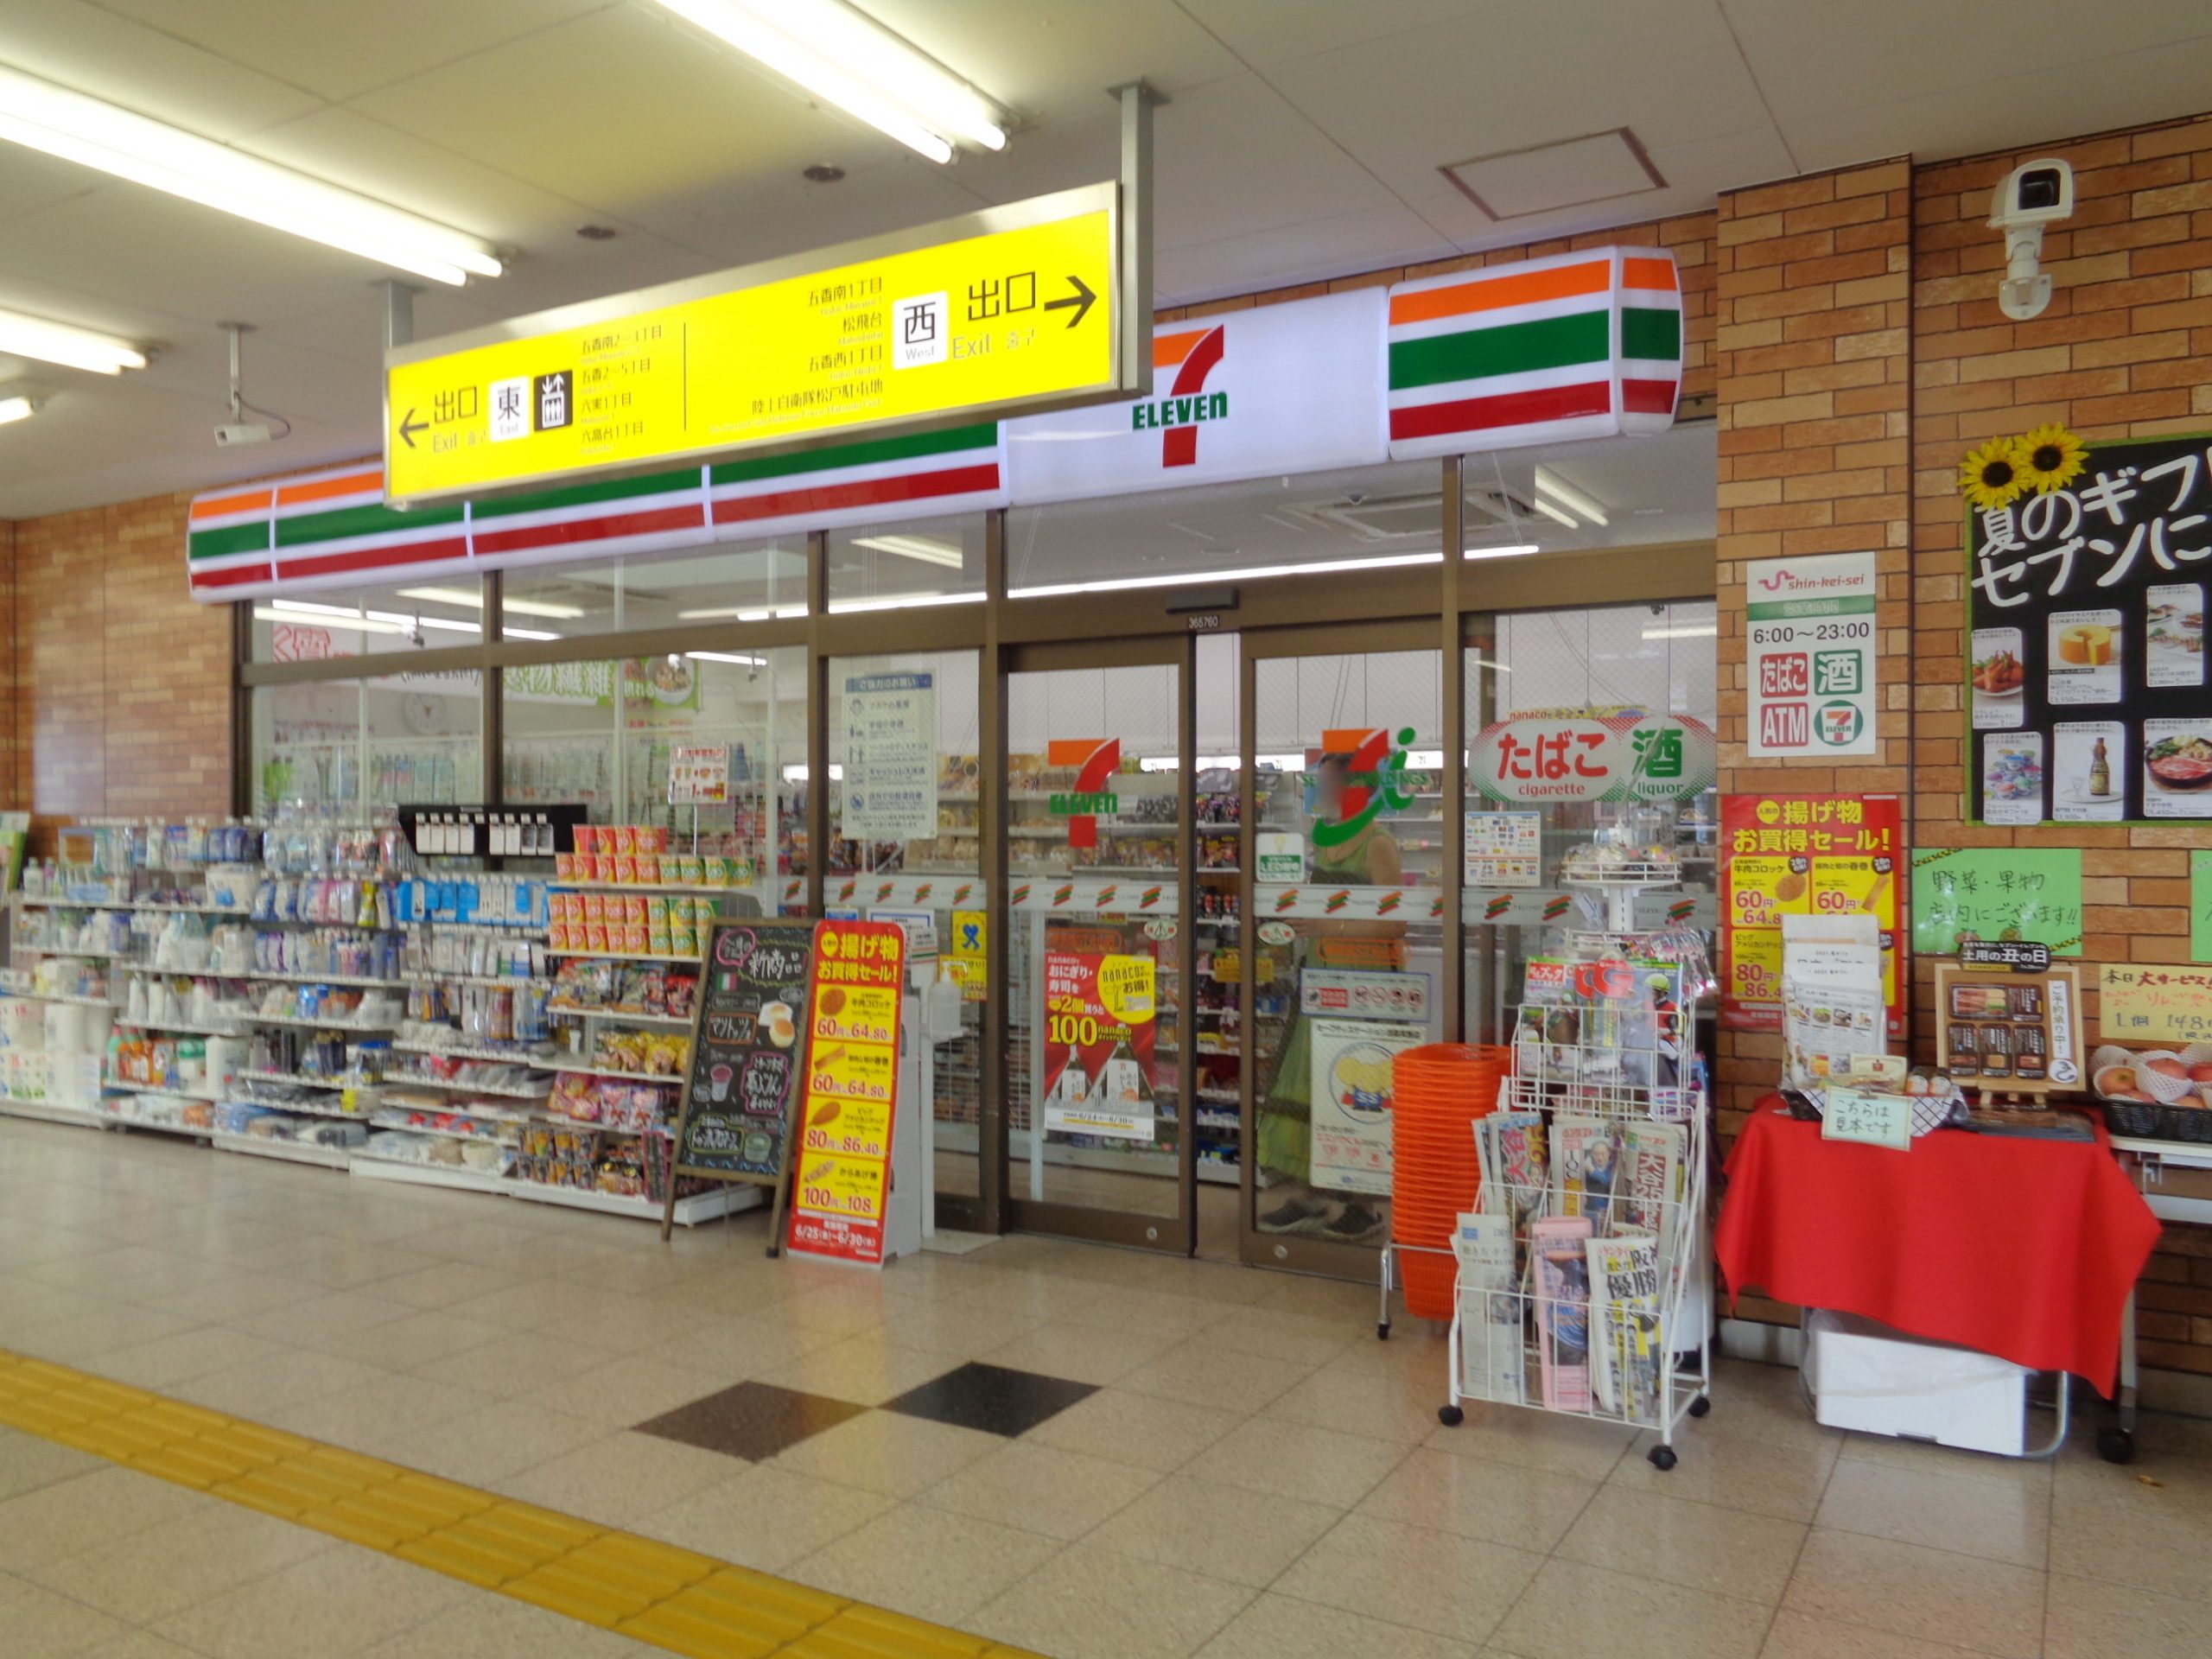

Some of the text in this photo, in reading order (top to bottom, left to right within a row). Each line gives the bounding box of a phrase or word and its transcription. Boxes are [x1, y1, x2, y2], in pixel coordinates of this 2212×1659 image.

[968, 271, 1035, 321] 出口
[903, 302, 936, 345] 西
[906, 346, 935, 361] West
[953, 334, 991, 359] Exit
[434, 386, 477, 424] 出口
[498, 385, 520, 421] 東
[433, 432, 457, 454] Exit
[1974, 447, 2212, 557] 夏のギフ
[1971, 515, 2212, 607] セブンに
[1788, 574, 1866, 591] shin-kei-sei
[1762, 656, 1807, 694] たばこ
[1817, 652, 1859, 693] 酒
[1762, 706, 1807, 744] ATM
[1497, 729, 1608, 780] たばこ
[1631, 728, 1683, 778] 酒
[1518, 783, 1586, 798] cigarette
[1637, 781, 1684, 796] liquor
[1783, 799, 1863, 824] 揚げ物
[1732, 828, 1891, 853] お買得セール!
[1932, 870, 2044, 895] 野菜・果物
[839, 933, 899, 962] 揚げ物
[1962, 948, 2047, 963] 土用の丑の日
[817, 960, 899, 983] お買得セール!
[2101, 969, 2133, 985] 本日
[1048, 1014, 1098, 1047] 100
[2166, 1014, 2212, 1030] 148
[1835, 1098, 1890, 1116] こちらは
[1834, 1116, 1891, 1135] 見本です
